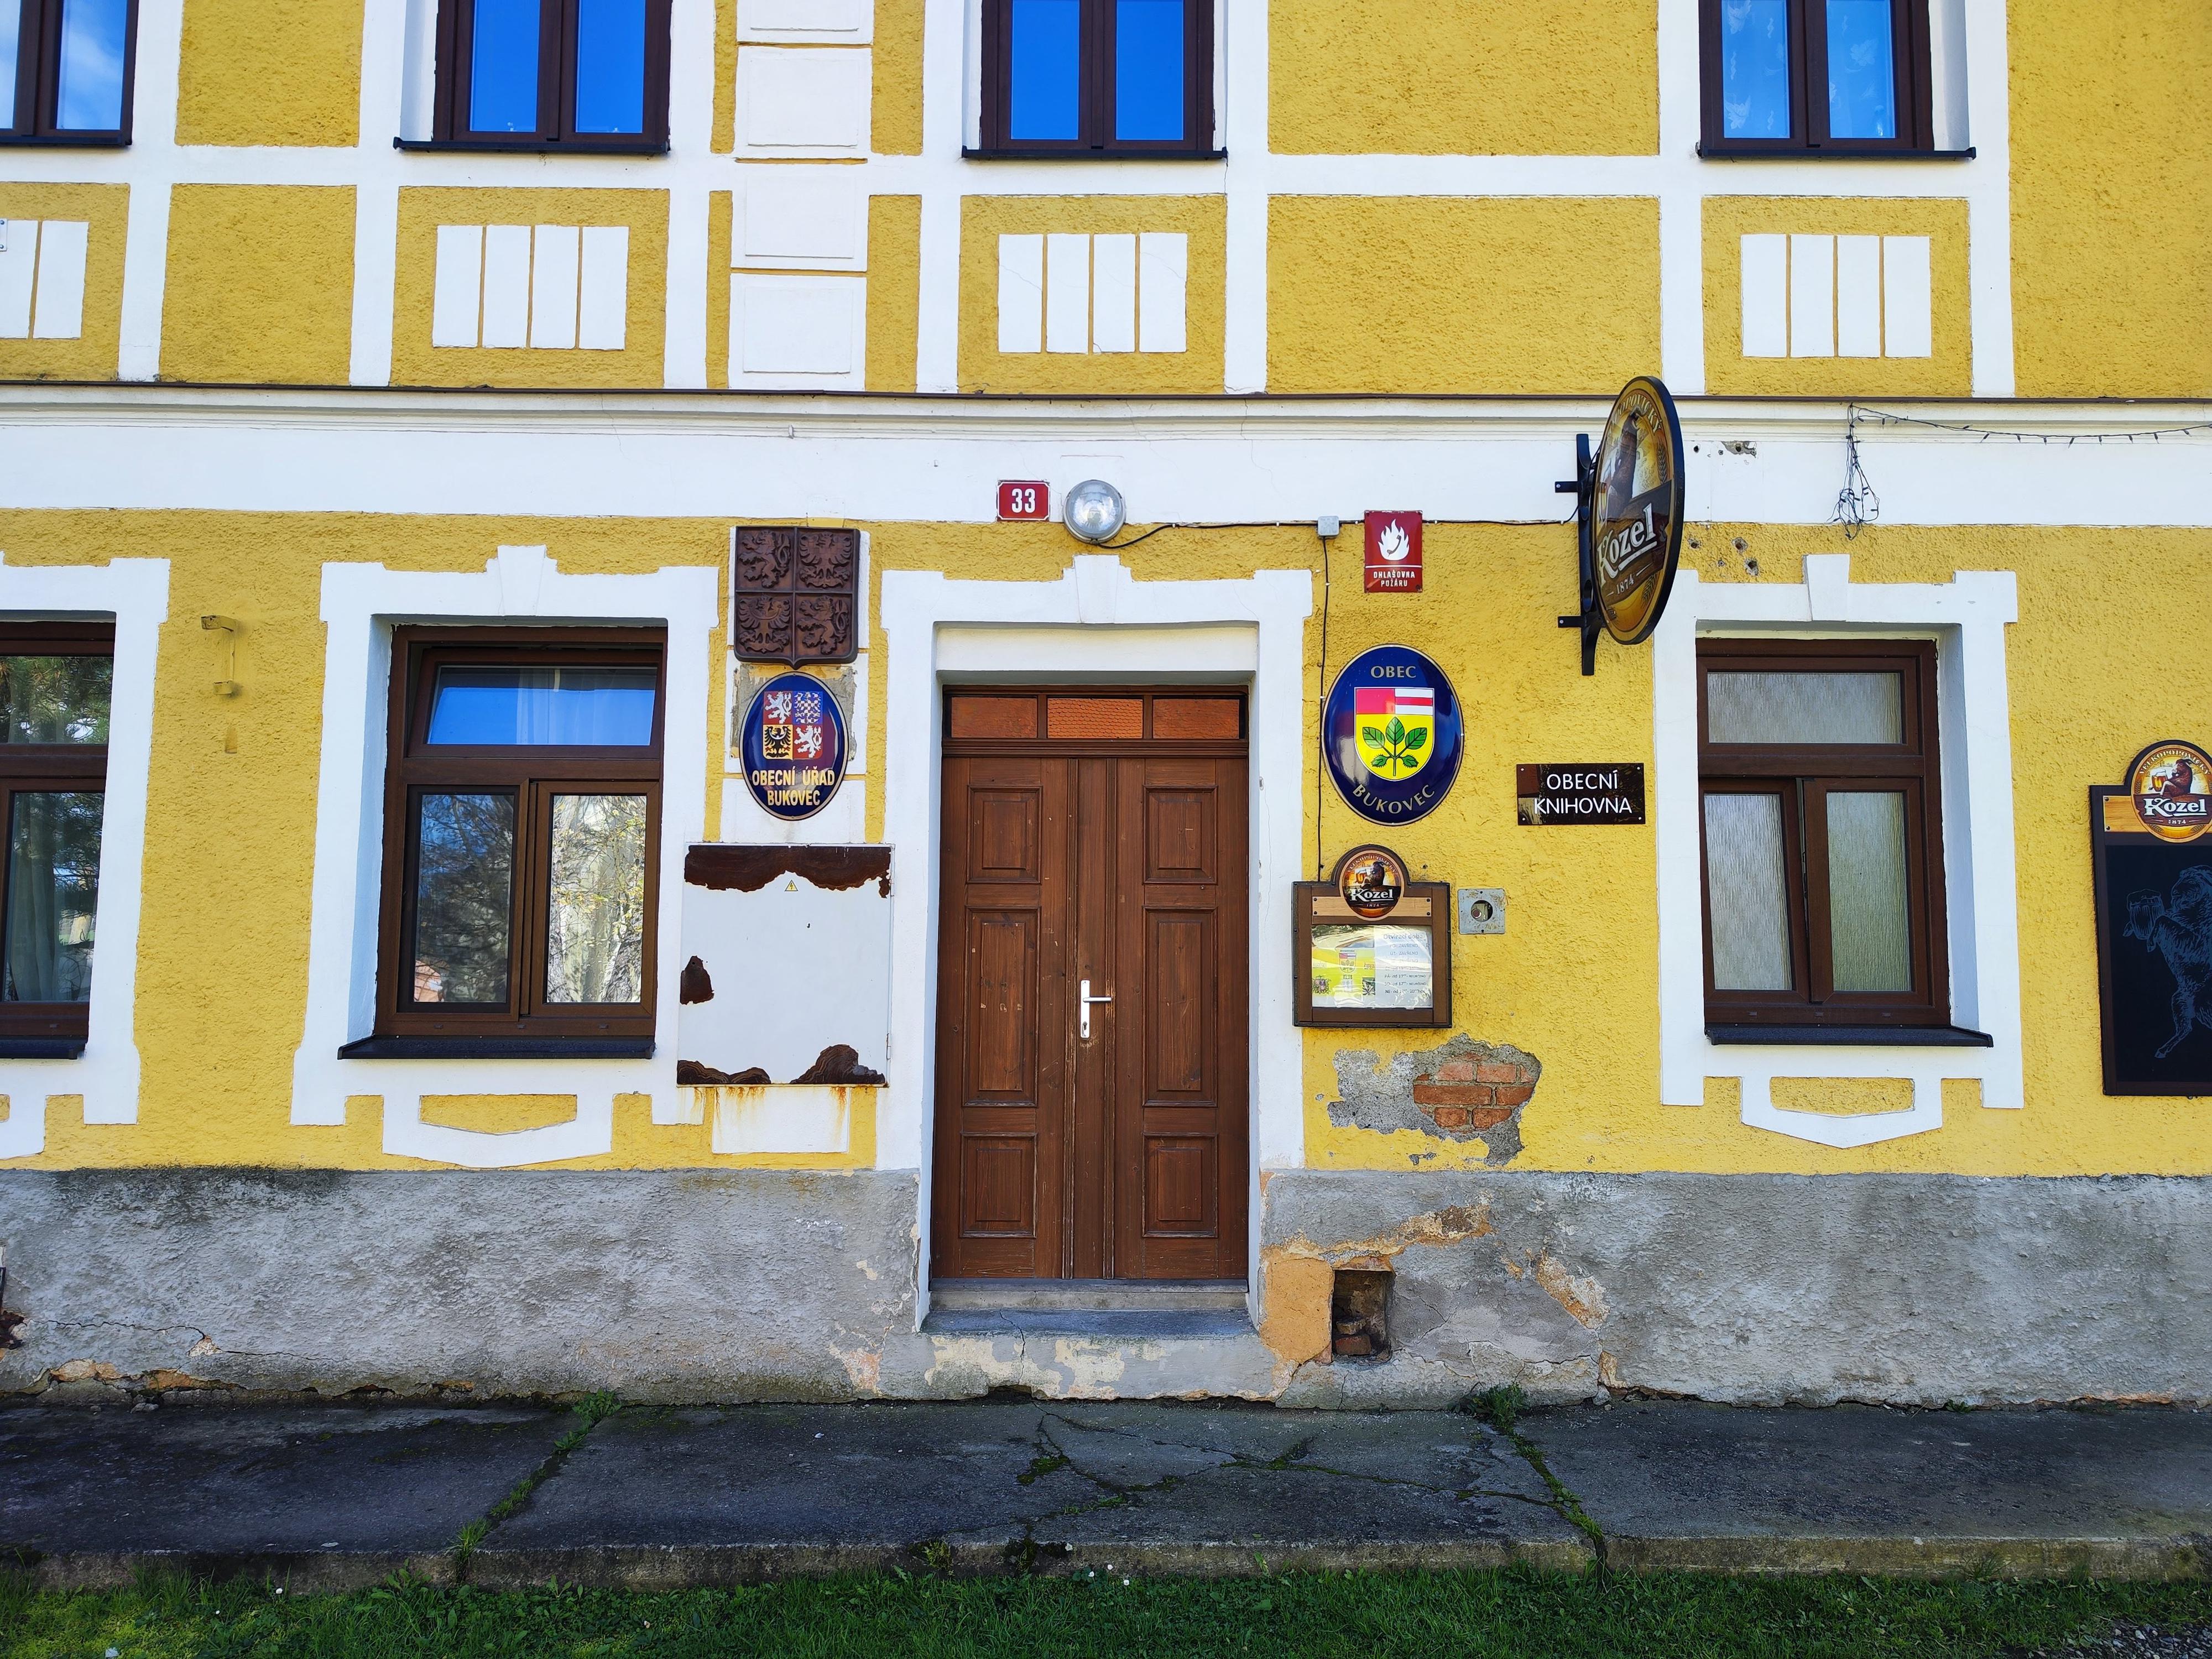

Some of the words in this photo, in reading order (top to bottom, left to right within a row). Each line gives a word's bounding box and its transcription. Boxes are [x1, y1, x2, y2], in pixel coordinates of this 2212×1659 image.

[1011, 488, 1036, 513] 33
[1597, 502, 1657, 588] Kozel
[1373, 570, 1415, 578] OHLAŠOVNA
[1616, 573, 1634, 594] 1874
[1370, 665, 1416, 678] OBEC
[752, 766, 796, 786] OBECNÍ
[802, 766, 835, 786] ÚŘAD
[1546, 769, 1618, 790] OBECNÍ
[767, 790, 821, 806] BUKOVEC
[1353, 784, 1435, 814] BUKOVEC
[1534, 797, 1632, 814] KNIHOVNA
[2143, 797, 2208, 817] Kozel
[1349, 888, 1394, 902] Kozel
